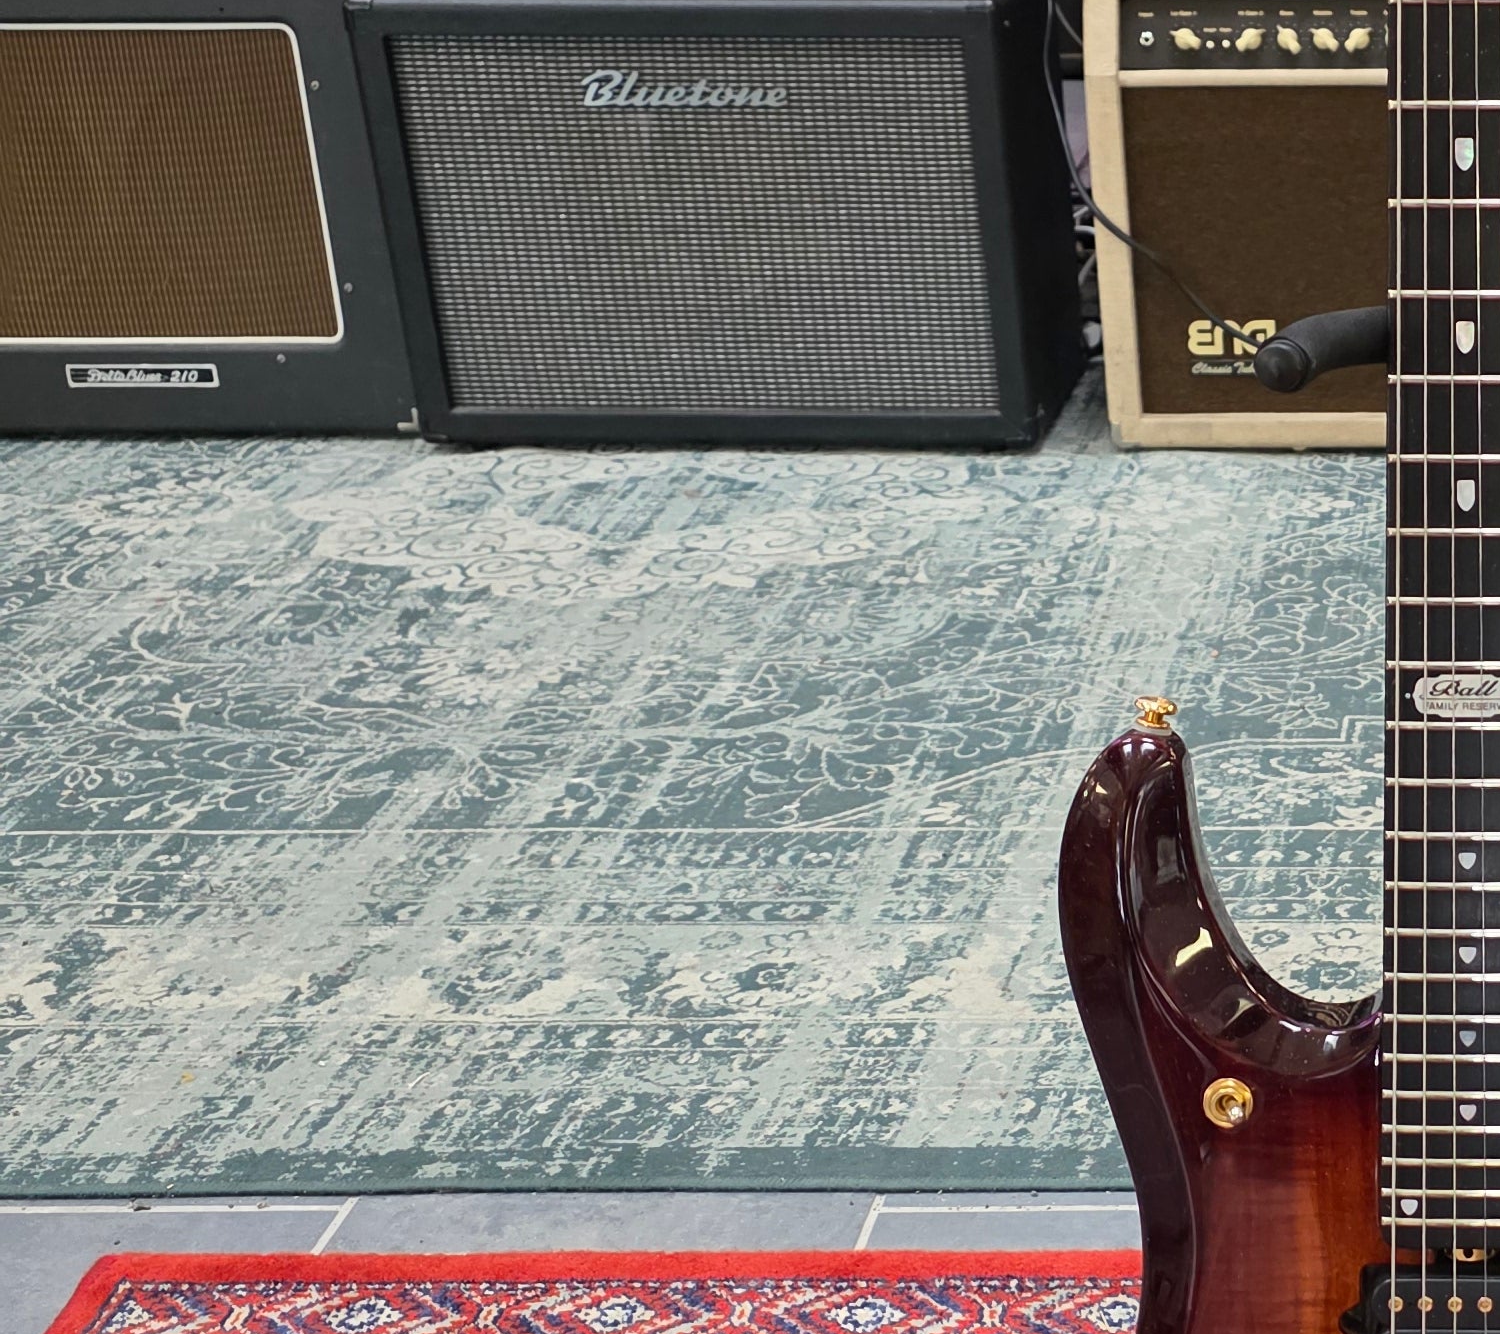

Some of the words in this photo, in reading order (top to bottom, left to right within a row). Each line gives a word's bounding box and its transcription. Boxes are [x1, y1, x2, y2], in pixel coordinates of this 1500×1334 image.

[580, 69, 788, 107] Bluetone
[169, 370, 199, 383] 210
[1429, 679, 1499, 697] Ball
[1425, 701, 1459, 711] FAMILY
